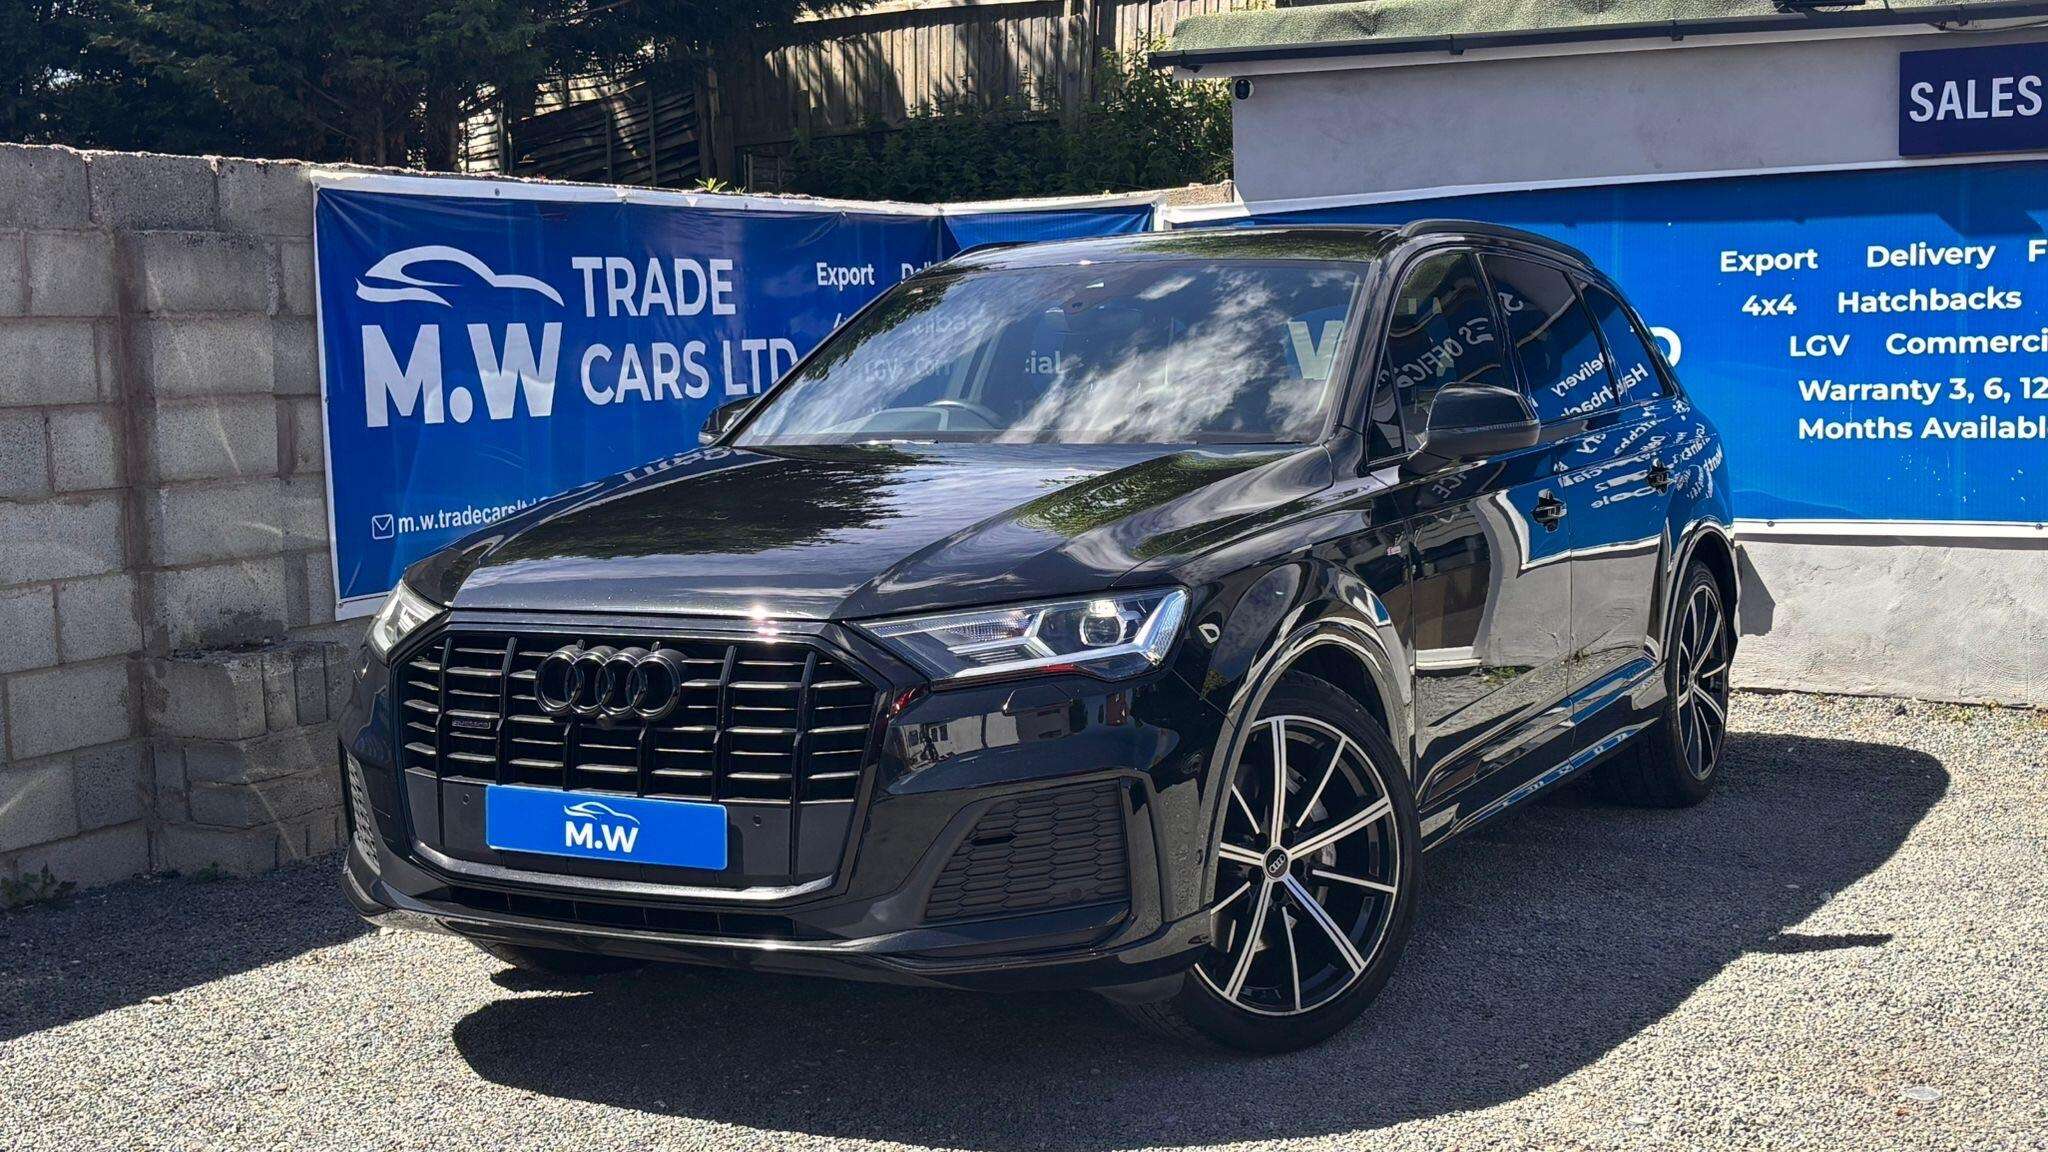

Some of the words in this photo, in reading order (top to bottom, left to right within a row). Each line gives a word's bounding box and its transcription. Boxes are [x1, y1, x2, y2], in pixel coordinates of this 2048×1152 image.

[1909, 75, 2043, 123] SALES
[1720, 247, 1818, 276] Export
[1866, 241, 1997, 270] Delivery
[571, 256, 736, 318] TRADE
[816, 262, 876, 292] Export
[1741, 293, 1798, 317] 4x4
[1837, 285, 2023, 314] Hatchbacks
[1789, 334, 1851, 358] LGV
[361, 321, 563, 428] M.W
[581, 340, 710, 406] CARS
[721, 338, 801, 396] LTD
[1798, 378, 1942, 406] Warranty
[1949, 378, 1976, 404] 3,
[1983, 377, 2012, 404] 6,
[2019, 376, 2048, 400] 12
[1798, 416, 1913, 440] Months
[1920, 414, 2048, 440] Availabl
[565, 820, 640, 853] M.W
